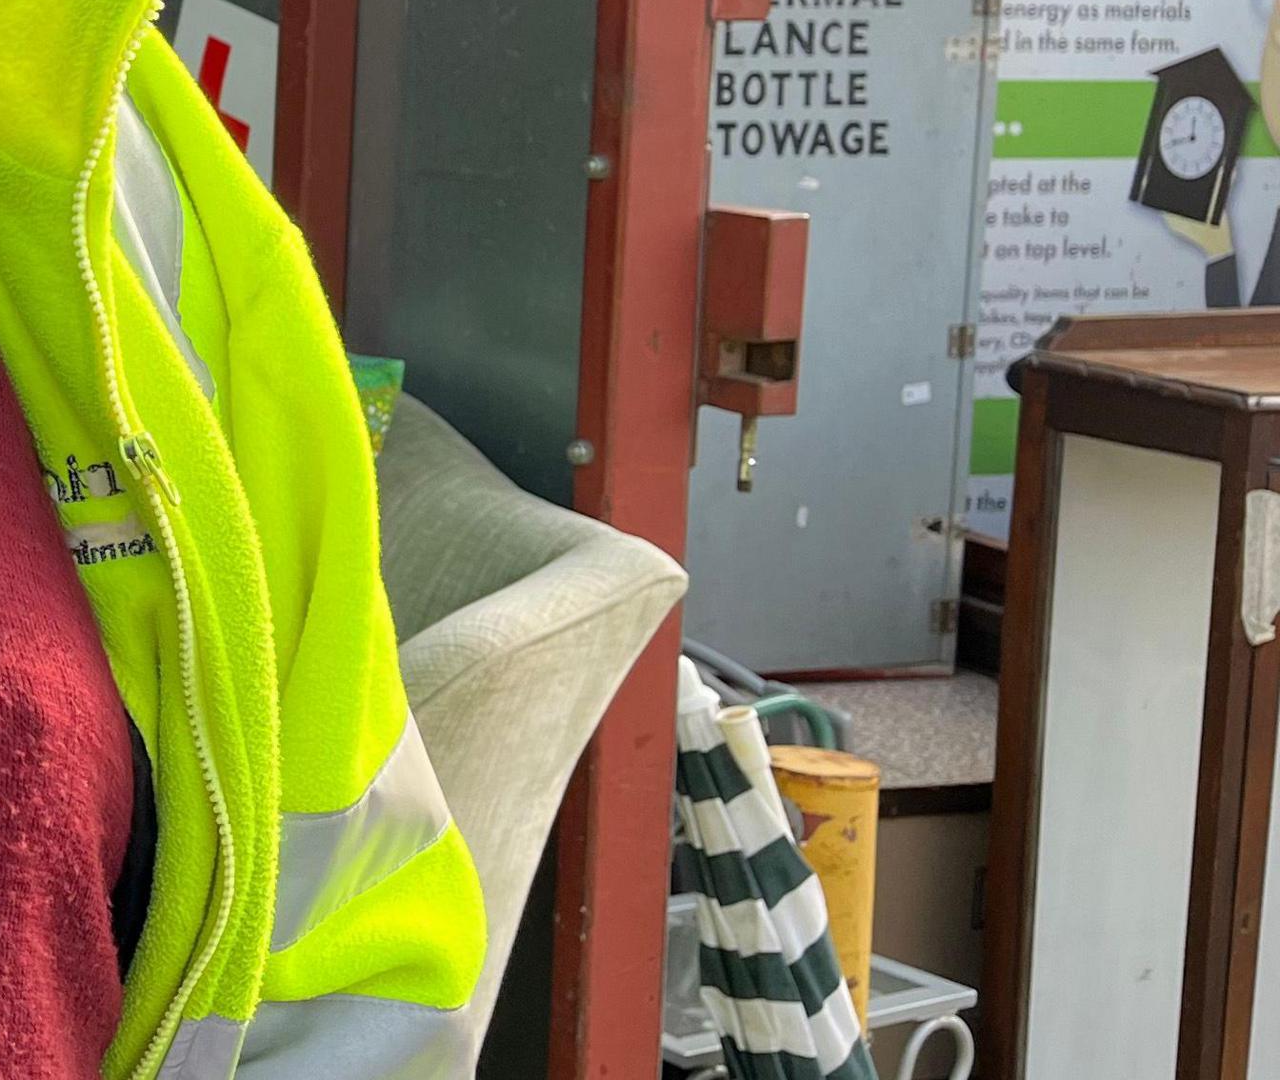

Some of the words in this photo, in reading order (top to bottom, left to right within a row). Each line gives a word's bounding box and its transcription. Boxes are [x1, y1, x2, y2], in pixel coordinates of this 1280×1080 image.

[1002, 3, 1072, 27] energy
[1077, 3, 1100, 21] as
[724, 20, 870, 56] LANCE
[1015, 32, 1033, 52] in
[1039, 32, 1068, 53] the
[1075, 36, 1125, 55] same
[1130, 30, 1181, 56] form.
[716, 72, 868, 107] BOTTLE
[716, 121, 890, 157] TOWAGE
[1037, 174, 1056, 194] at
[1061, 170, 1092, 193] the
[1002, 202, 1046, 227] take
[1050, 207, 1070, 227] to
[994, 242, 1021, 260] on
[1025, 239, 1057, 265] top
[1062, 234, 1113, 260] level.
[1073, 281, 1101, 300] that
